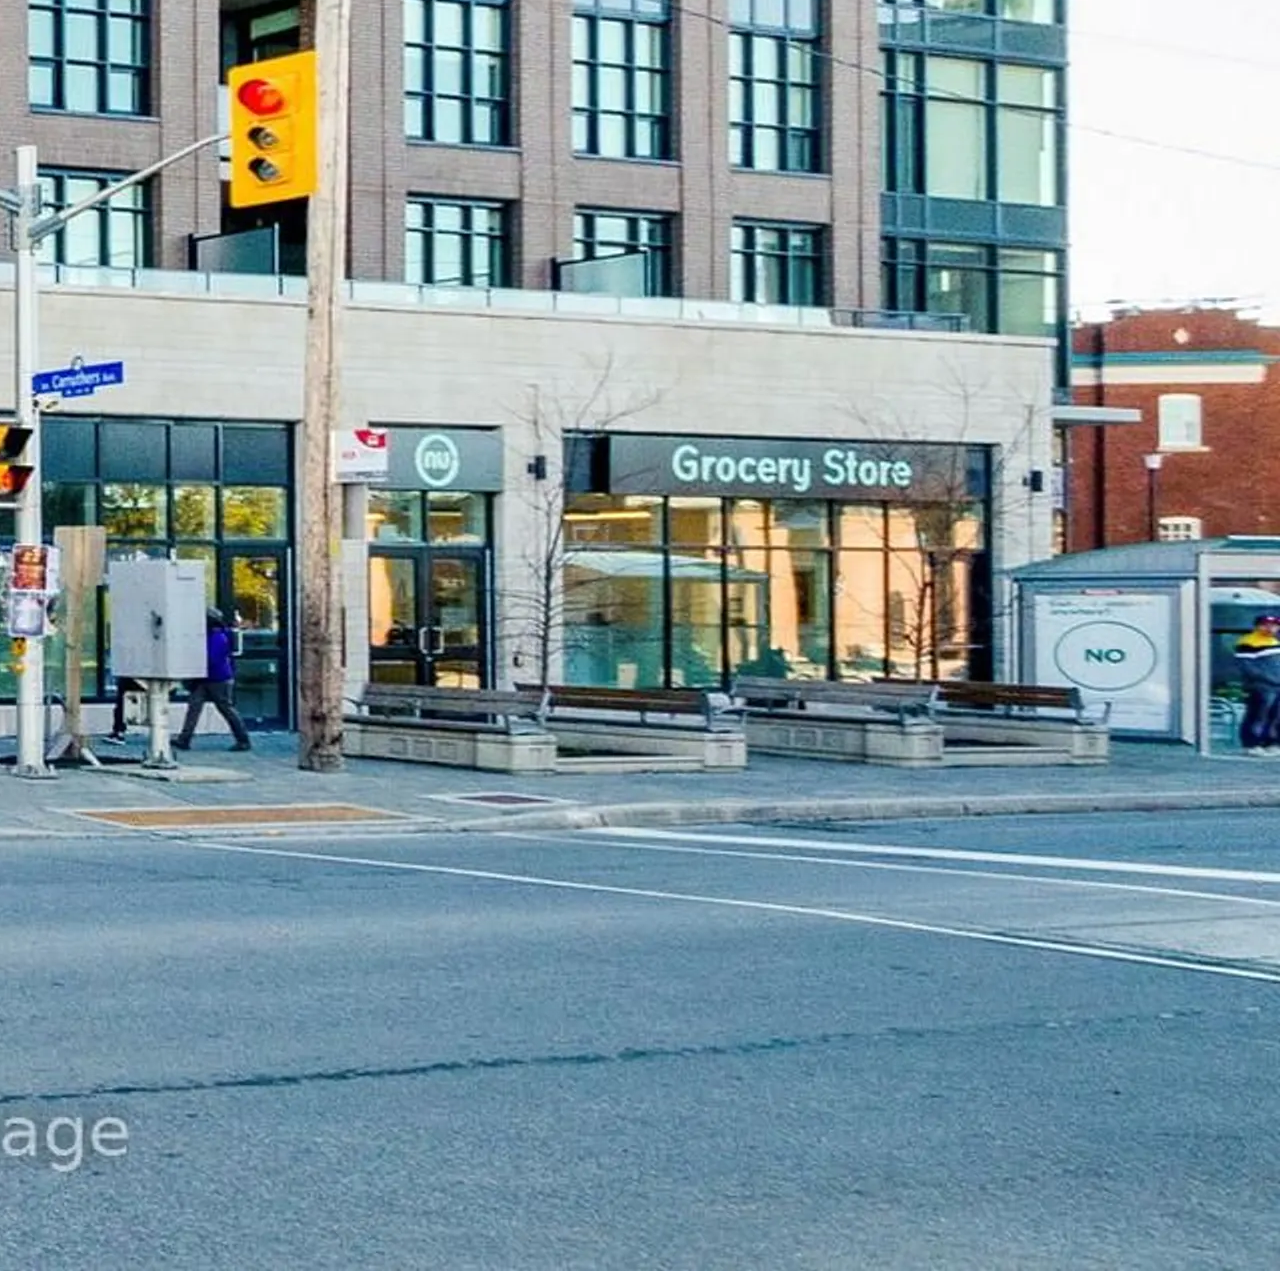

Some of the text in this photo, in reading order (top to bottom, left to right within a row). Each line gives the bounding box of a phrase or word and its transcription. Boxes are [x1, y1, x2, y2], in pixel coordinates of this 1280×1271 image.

[671, 444, 913, 492] Grocery Store
[1085, 648, 1126, 664] NO
